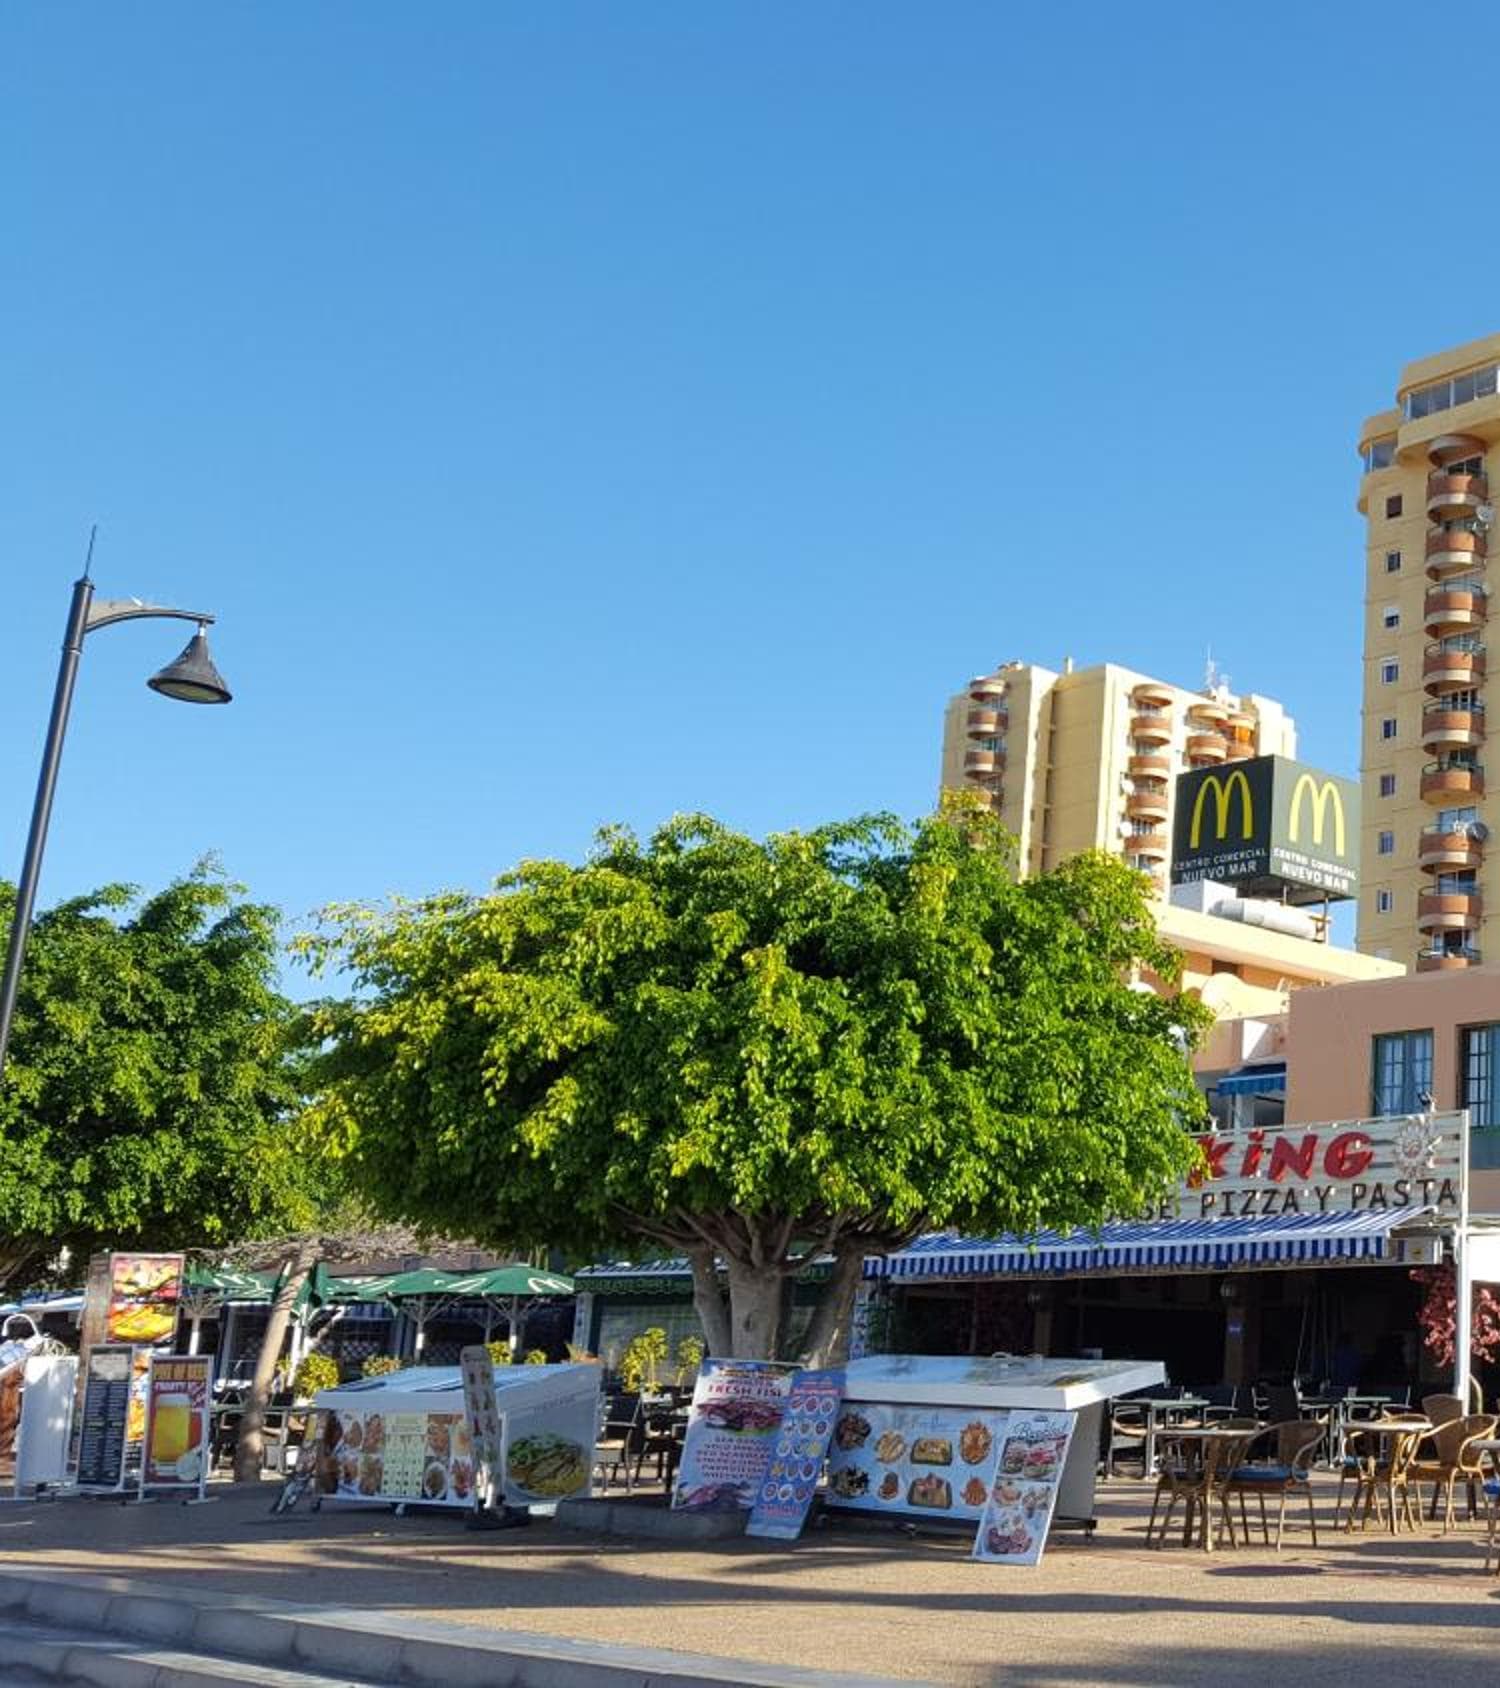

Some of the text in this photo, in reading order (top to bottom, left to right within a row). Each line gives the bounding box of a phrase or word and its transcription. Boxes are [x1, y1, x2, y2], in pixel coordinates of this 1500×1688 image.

[1174, 848, 1267, 871] CENTRO COMERCIAL
[1181, 860, 1257, 883] NUEVO MAR
[1273, 847, 1358, 881] CENTRO COMERCIAL
[1281, 861, 1350, 891] NUEVO MAR
[1201, 1184, 1300, 1218] PIZZA
[1314, 1185, 1334, 1212] Y
[1352, 1178, 1457, 1209] PASTA
